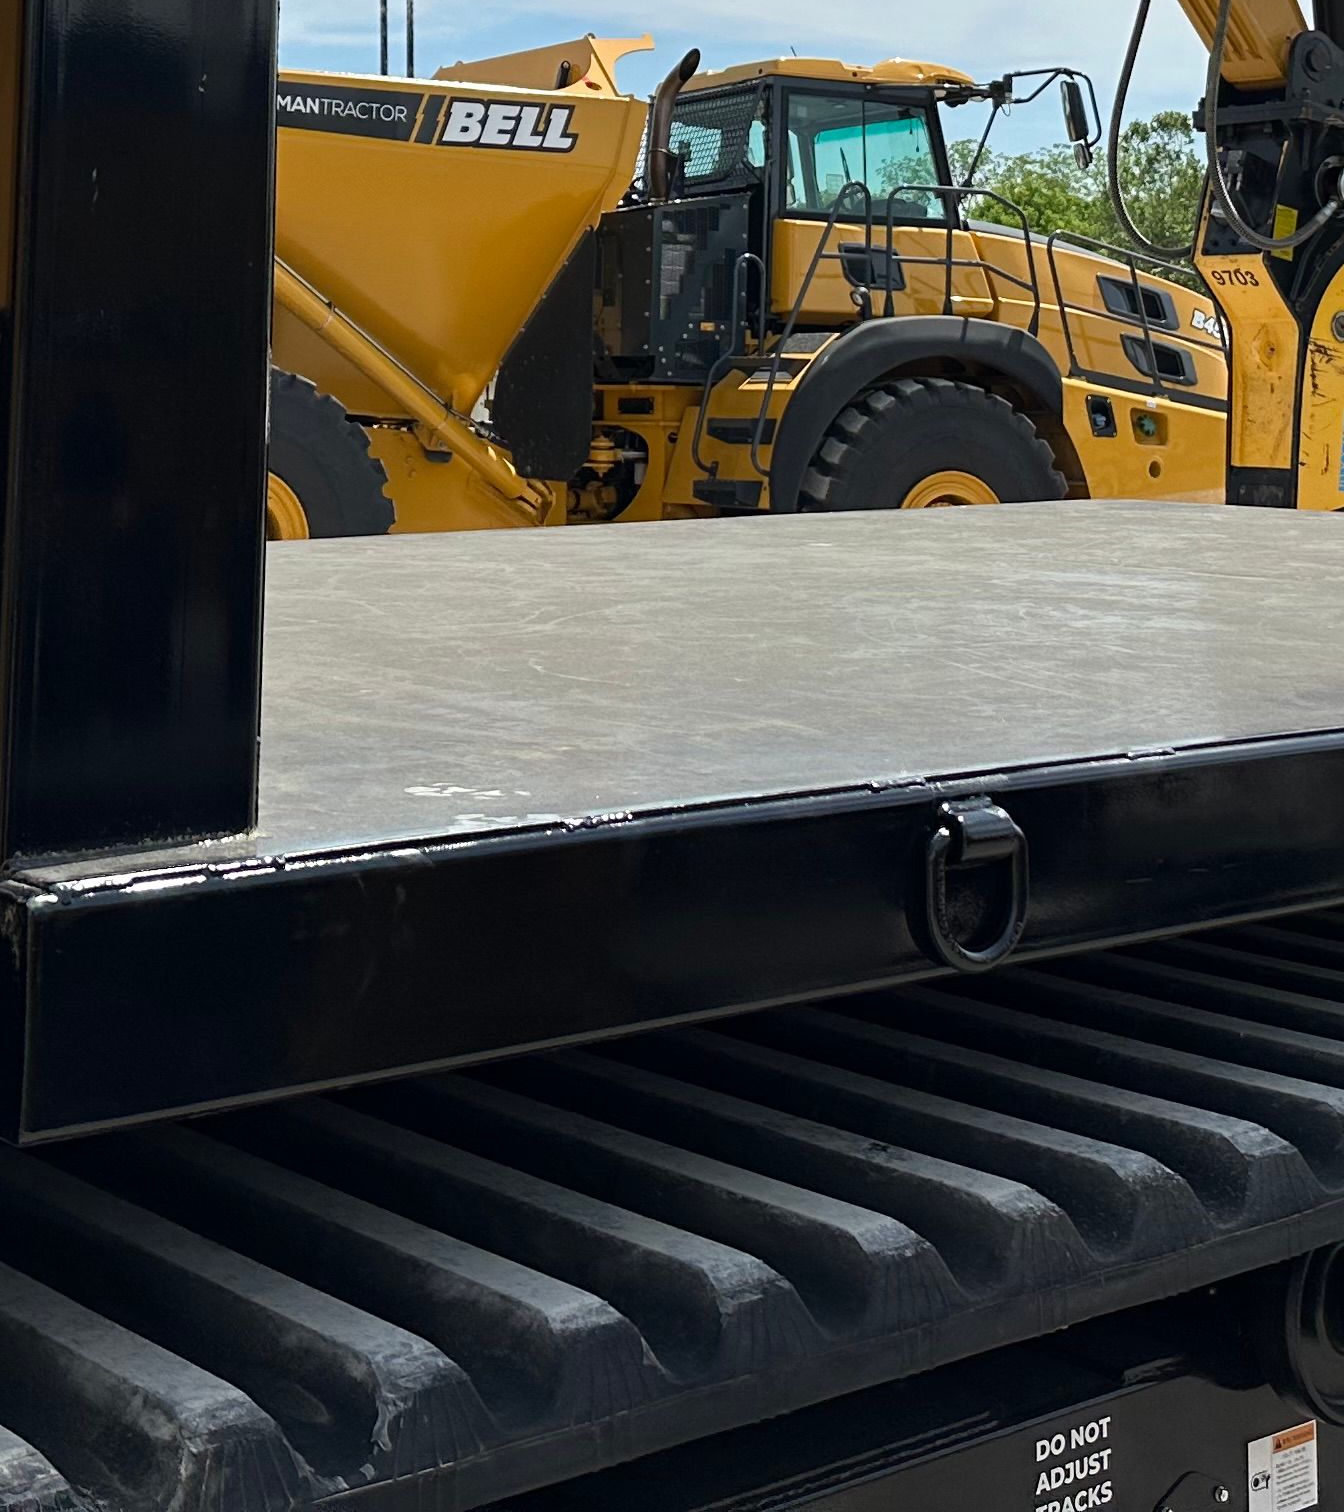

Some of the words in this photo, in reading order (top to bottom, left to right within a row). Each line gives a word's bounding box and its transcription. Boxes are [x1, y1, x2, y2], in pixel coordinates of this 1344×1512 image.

[441, 100, 575, 150] BELL
[1211, 268, 1260, 288] 9703
[1036, 1433, 1066, 1462] DO
[1070, 1416, 1111, 1450] NOT
[1035, 1448, 1112, 1496] ADJUST
